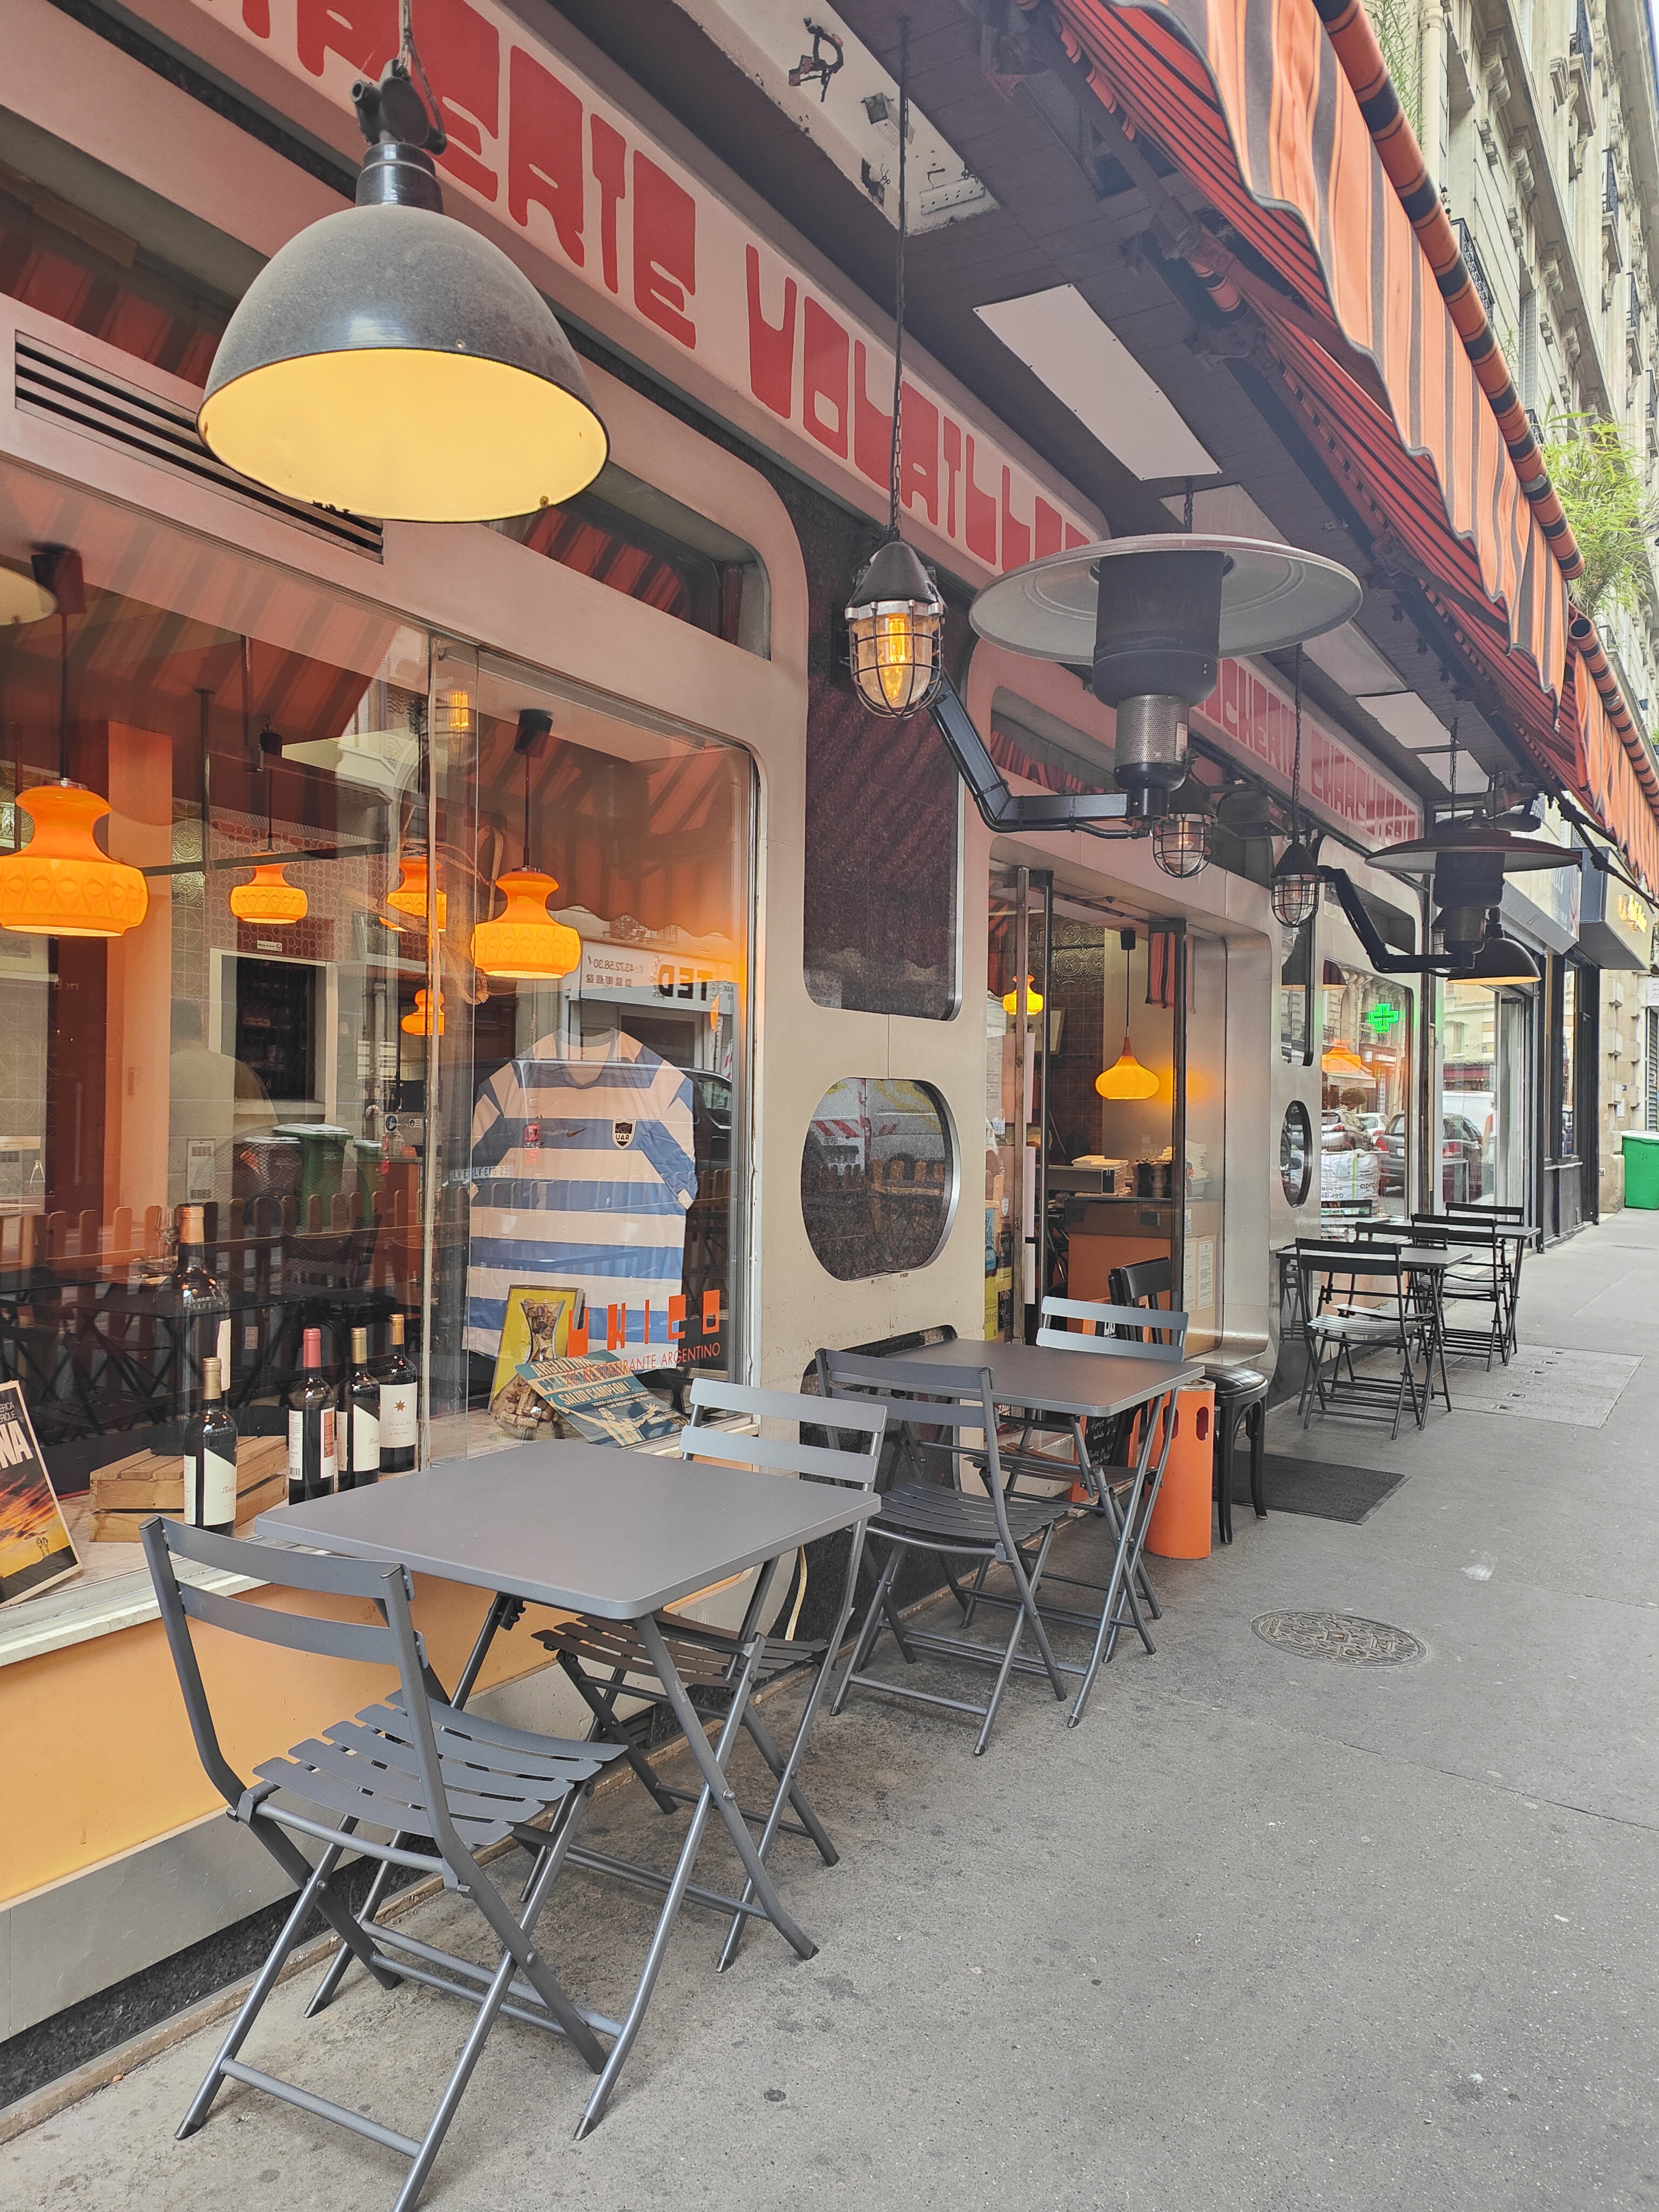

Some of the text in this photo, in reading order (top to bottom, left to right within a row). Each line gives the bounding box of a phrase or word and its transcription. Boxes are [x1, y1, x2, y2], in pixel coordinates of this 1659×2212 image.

[242, 0, 695, 349] PERIE
[568, 1290, 720, 1358] UNICO
[986, 1312, 997, 1324] 2015
[530, 1356, 594, 1378] ARGENTINA
[567, 1343, 720, 1385] EL RESTAURANTE ARGENTINO
[558, 1390, 585, 1405] SALUD
